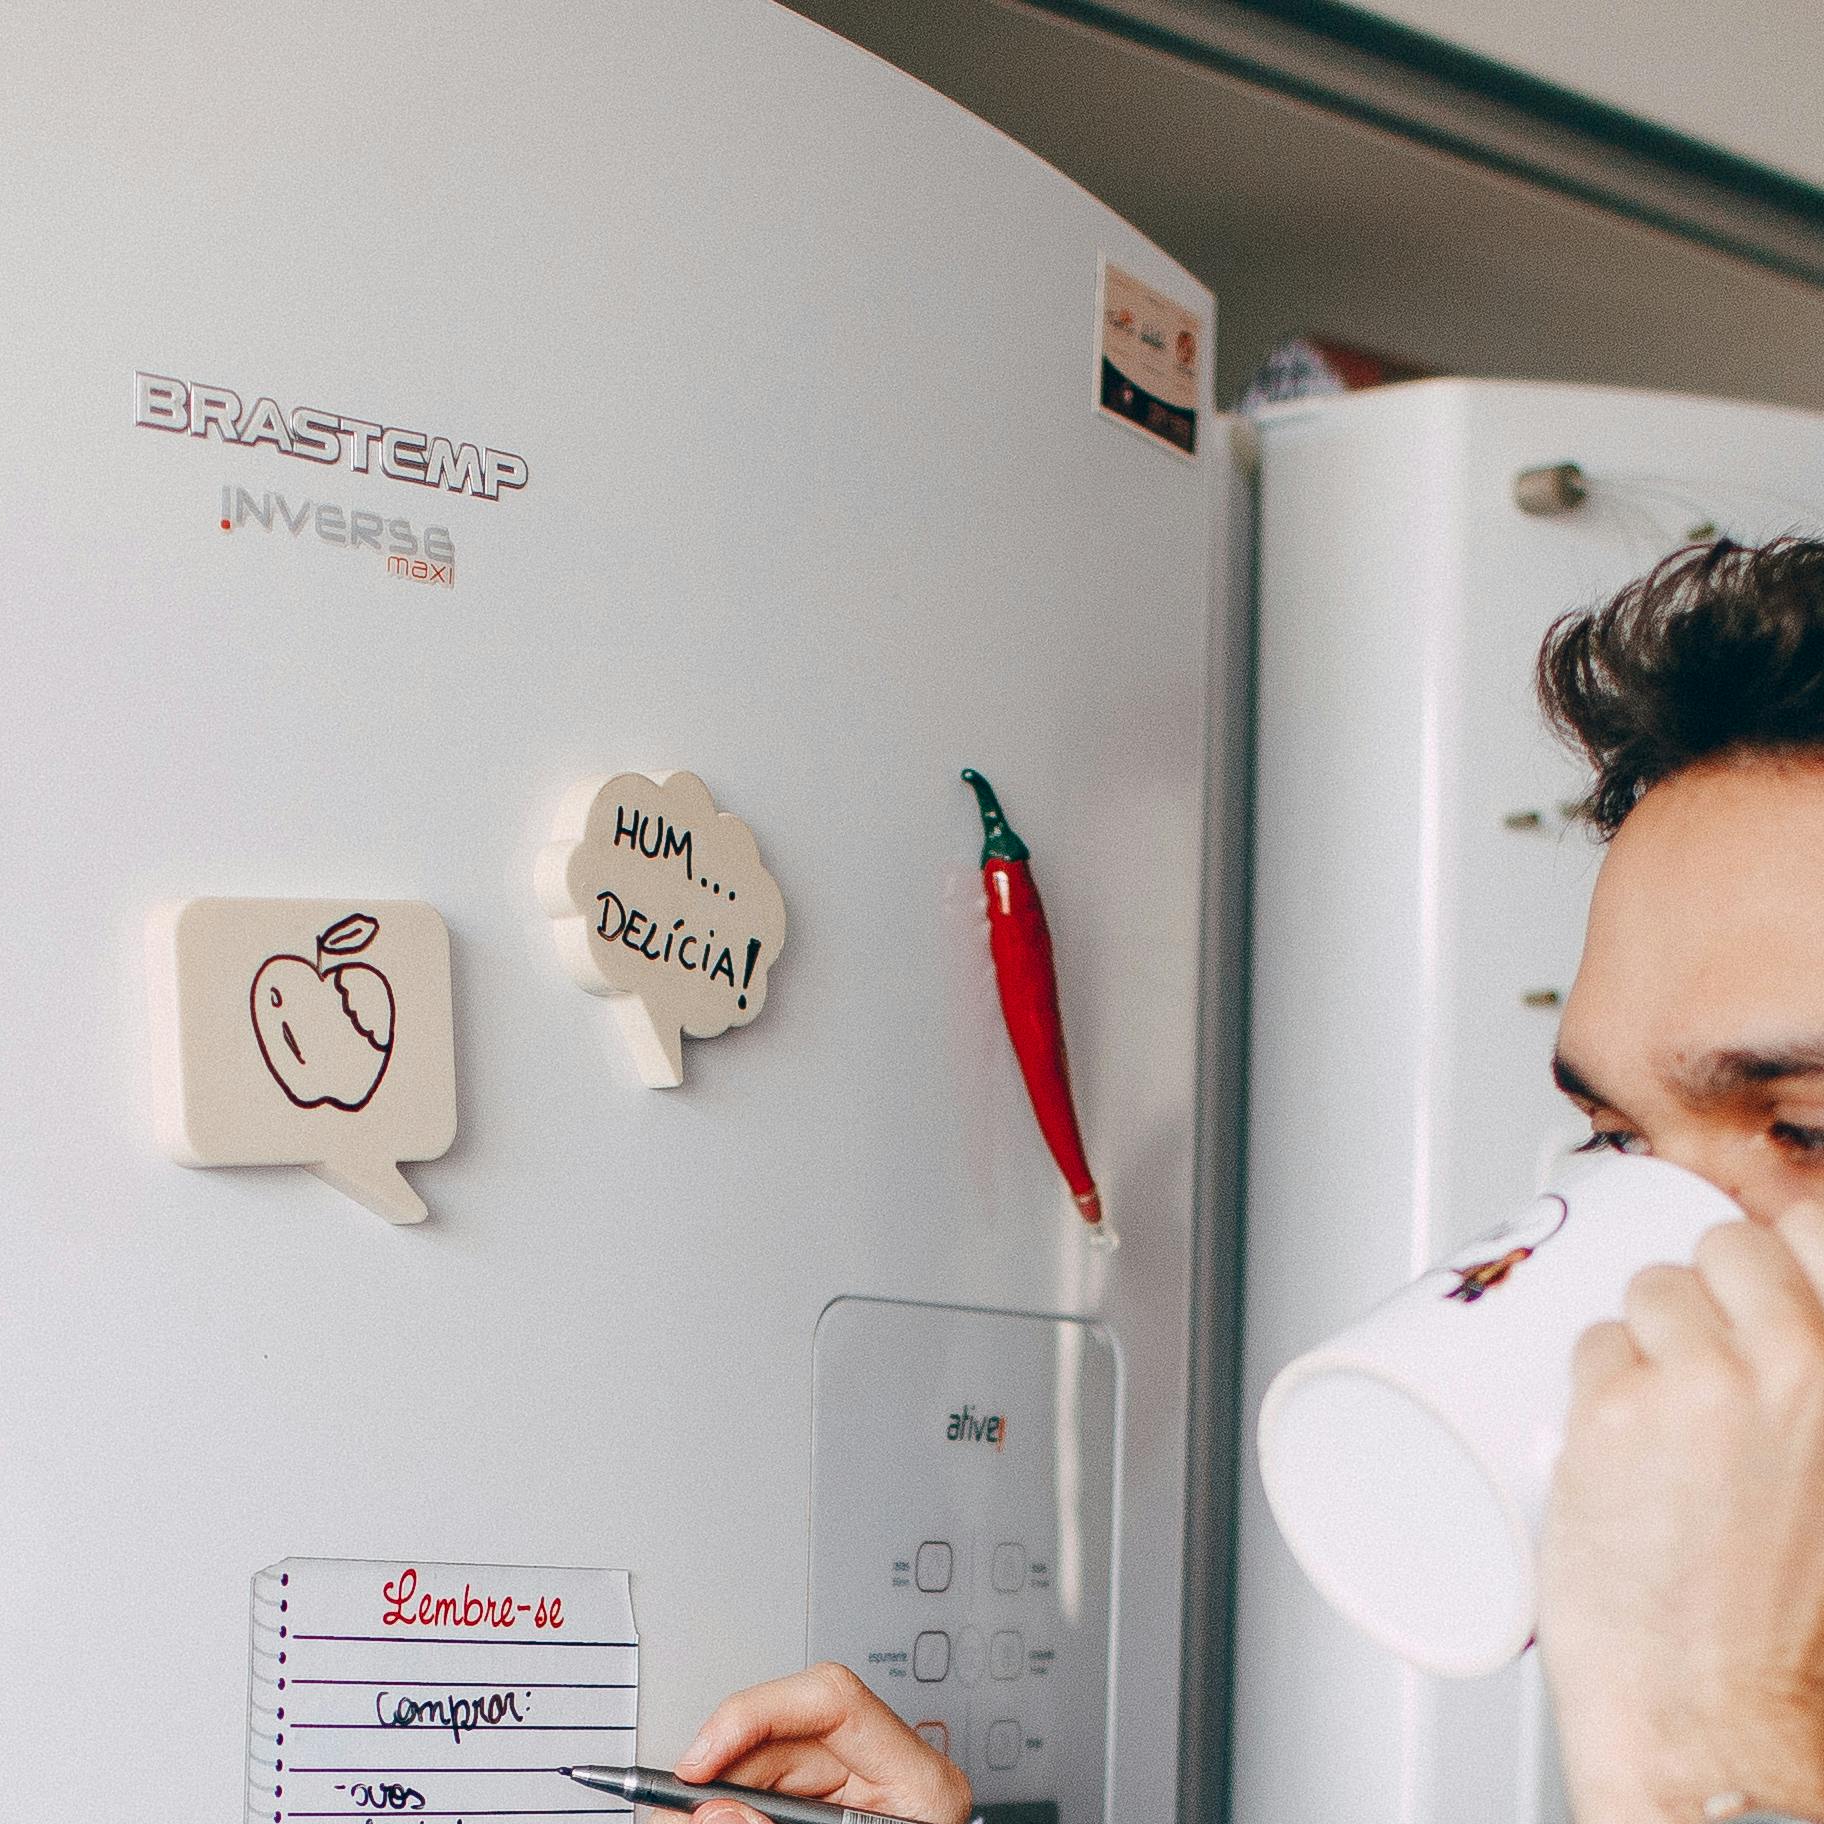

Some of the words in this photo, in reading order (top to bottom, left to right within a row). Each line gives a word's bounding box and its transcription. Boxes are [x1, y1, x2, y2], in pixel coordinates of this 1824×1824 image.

[133, 369, 530, 501] BRASTEMP
[219, 484, 456, 565] INVERSE
[386, 555, 455, 587] maxi
[613, 805, 737, 902] HUM...
[381, 1568, 565, 1629] Lembre-se
